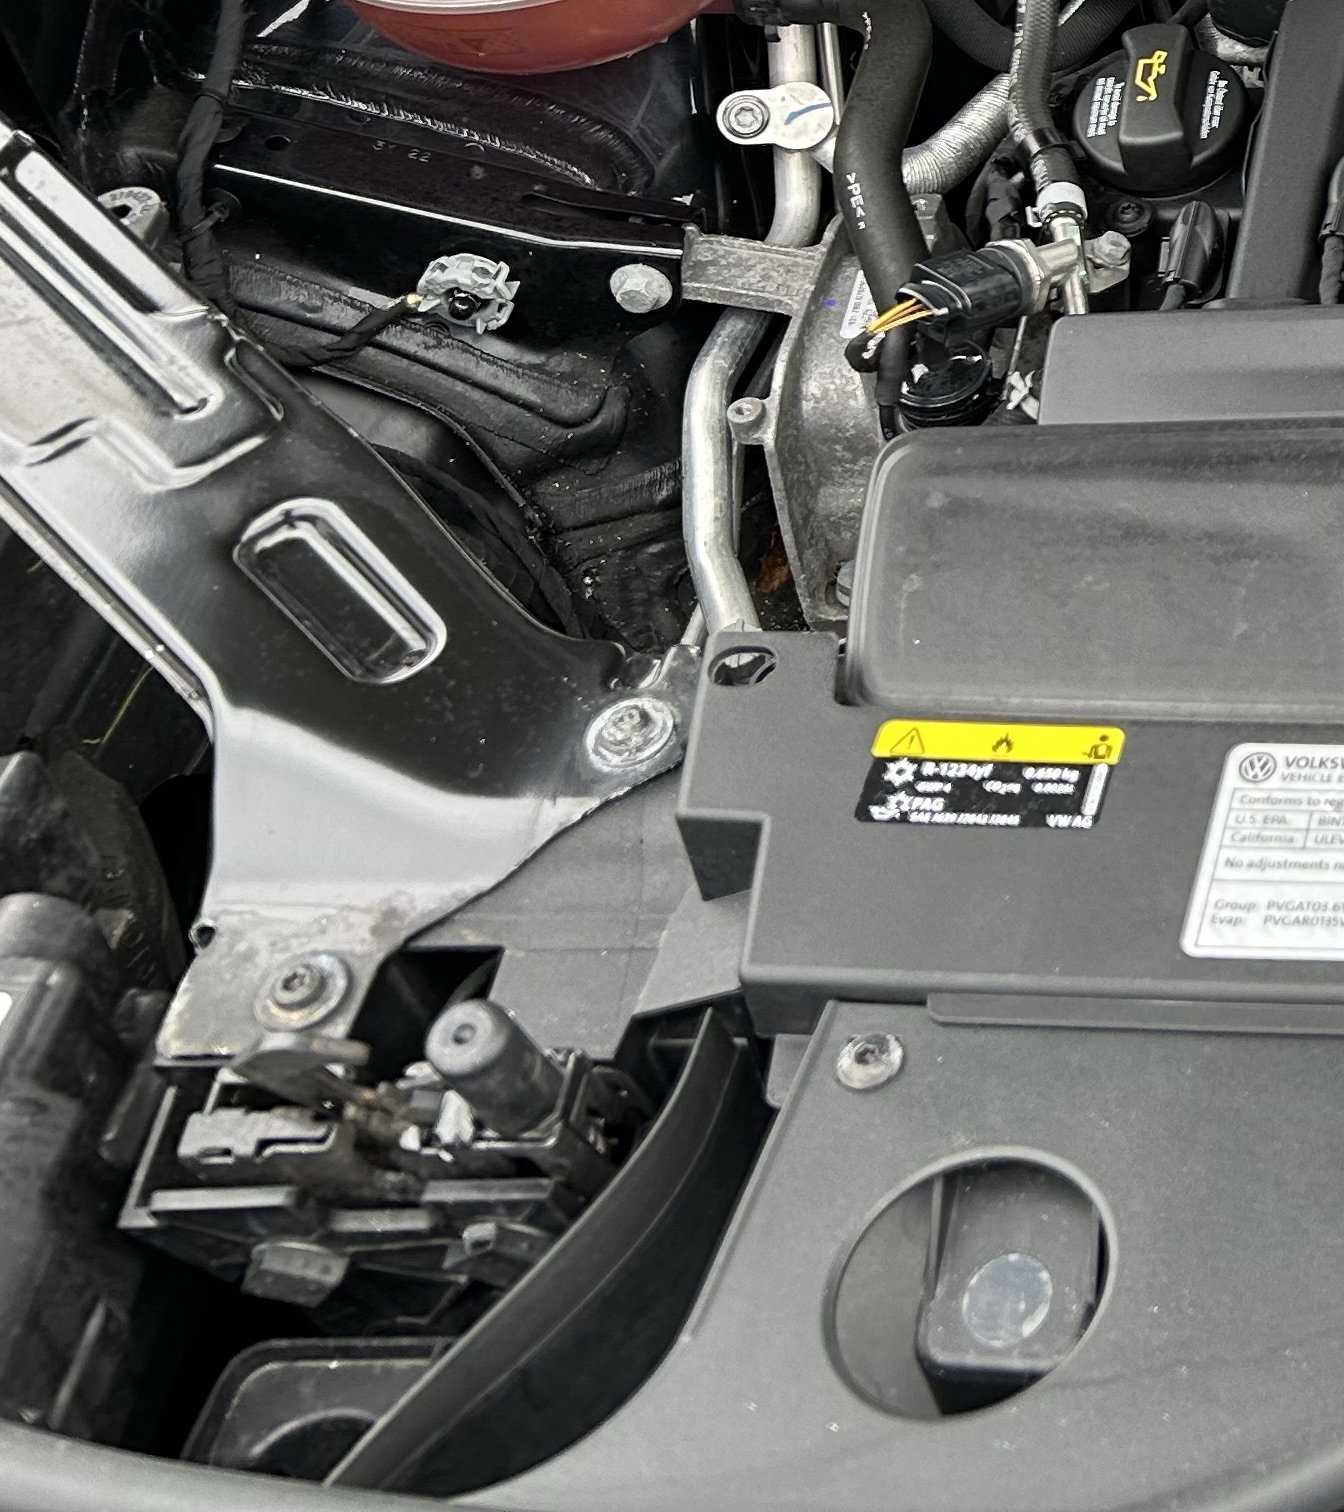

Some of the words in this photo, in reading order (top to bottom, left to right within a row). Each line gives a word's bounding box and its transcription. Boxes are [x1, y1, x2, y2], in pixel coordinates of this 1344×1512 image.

[1062, 768, 1081, 783] kg
[1282, 772, 1333, 783] VEHICLE
[911, 797, 946, 812] PAG
[1240, 794, 1303, 805] Conforms
[1307, 796, 1321, 806] to
[1045, 814, 1072, 828] VW
[1072, 815, 1093, 829] AG
[1225, 857, 1242, 868] No
[1247, 858, 1330, 872] adjustments
